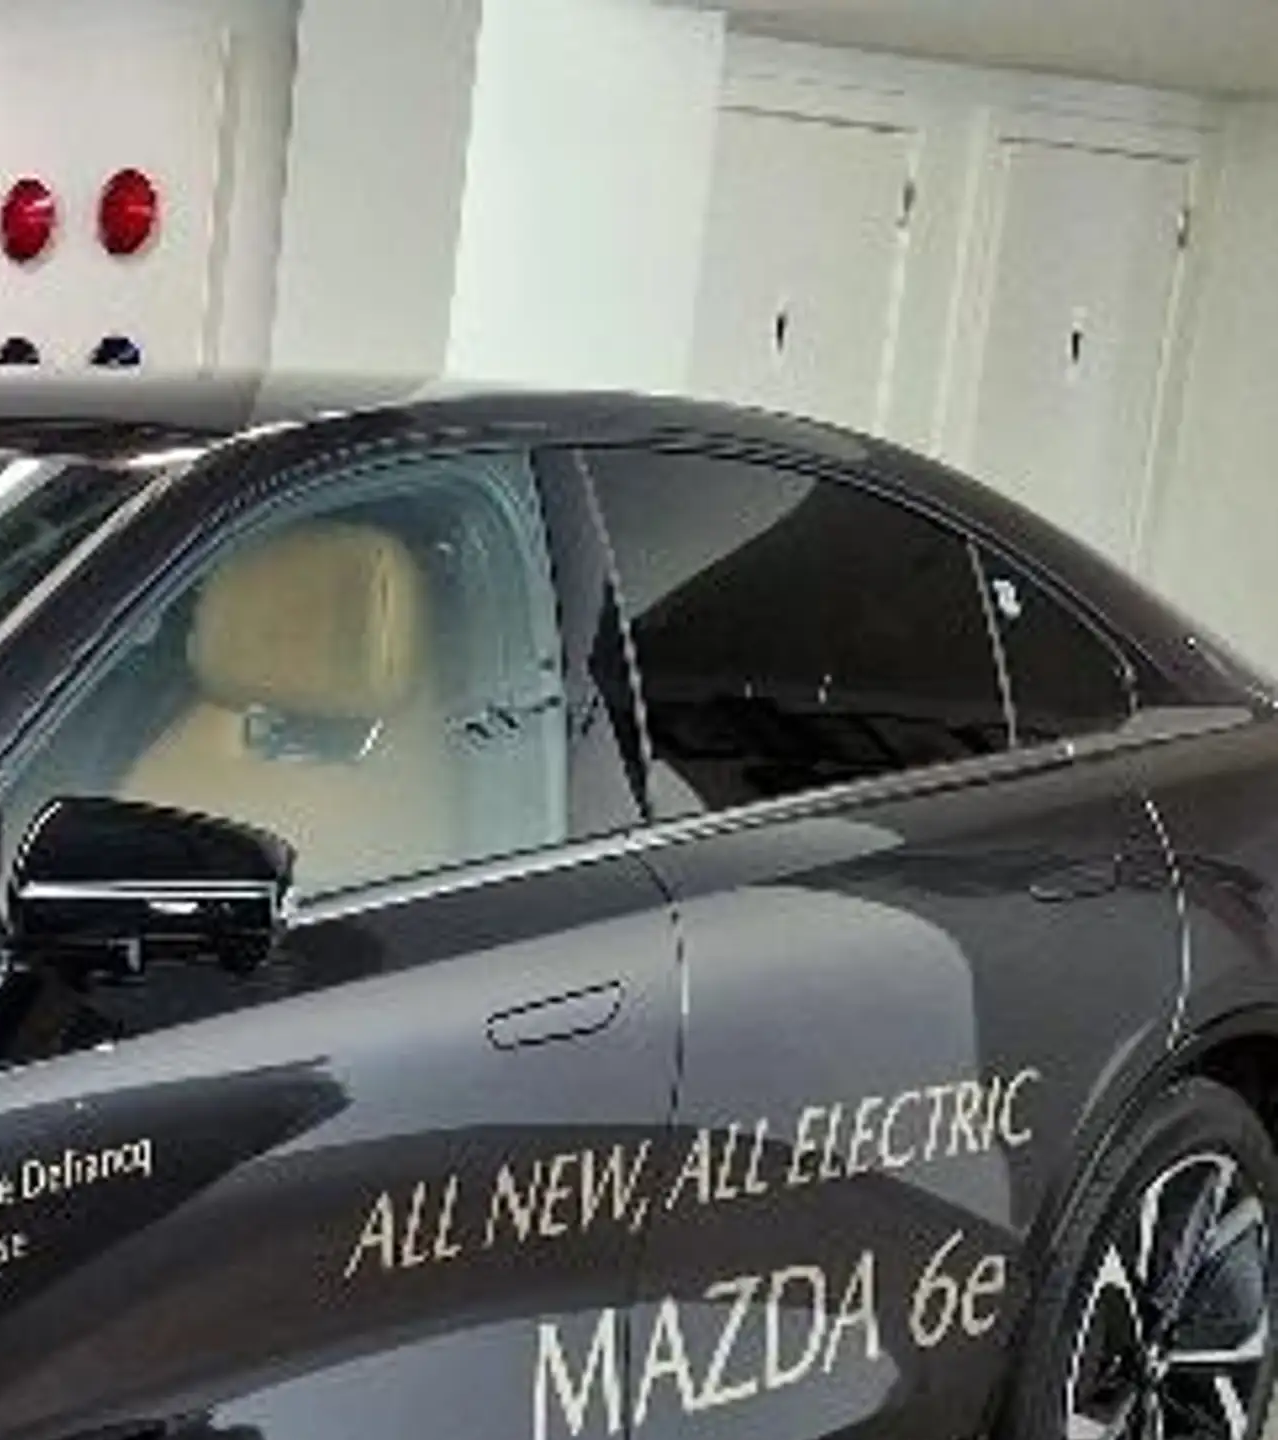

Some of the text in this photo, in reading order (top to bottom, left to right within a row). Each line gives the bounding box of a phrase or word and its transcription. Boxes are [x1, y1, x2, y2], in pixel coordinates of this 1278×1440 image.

[343, 1068, 1041, 1279] ALL NEW, ALL ELECTRIC
[907, 1228, 1006, 1348] 6e
